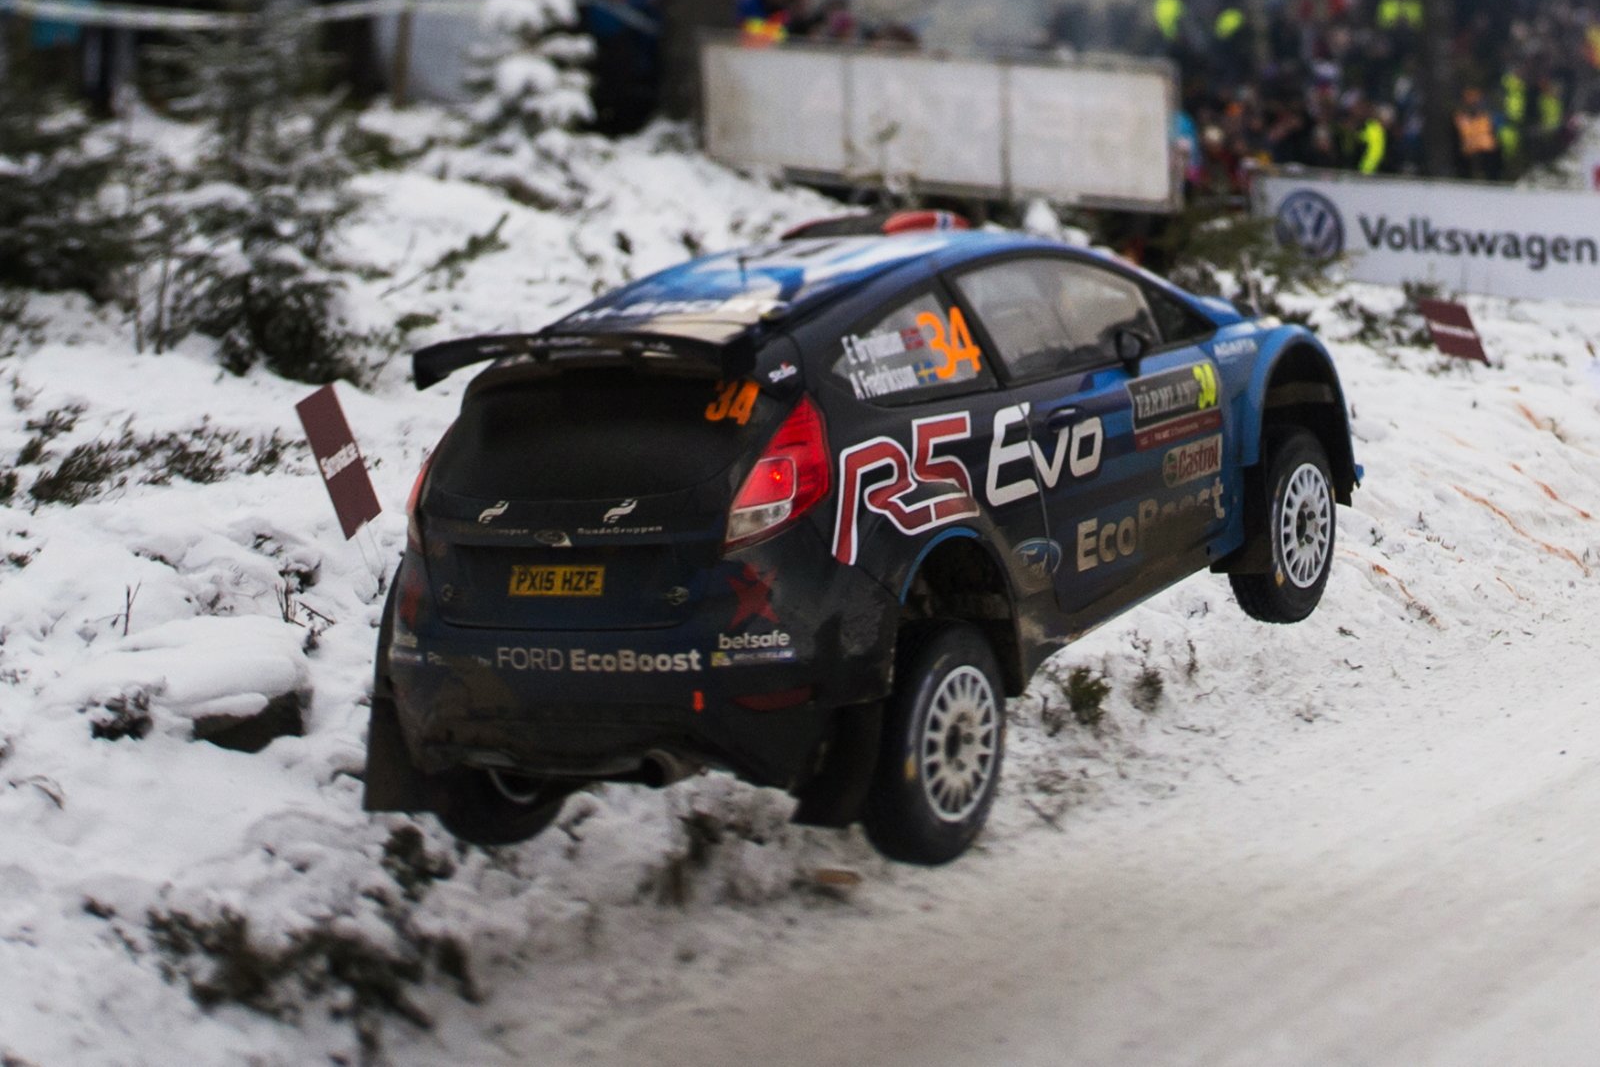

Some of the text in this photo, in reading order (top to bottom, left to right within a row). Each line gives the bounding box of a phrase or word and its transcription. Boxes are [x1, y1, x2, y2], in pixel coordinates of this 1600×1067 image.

[1358, 212, 1598, 271] Volkswagen
[917, 307, 980, 378] 34
[705, 381, 760, 425] 34
[1178, 439, 1220, 479] Castrol
[832, 401, 1103, 565] R5 Evo
[515, 570, 599, 592] PX15 HZF
[497, 647, 564, 671] FORD
[570, 648, 702, 672] EcoBoost
[718, 630, 790, 650] betsafe
